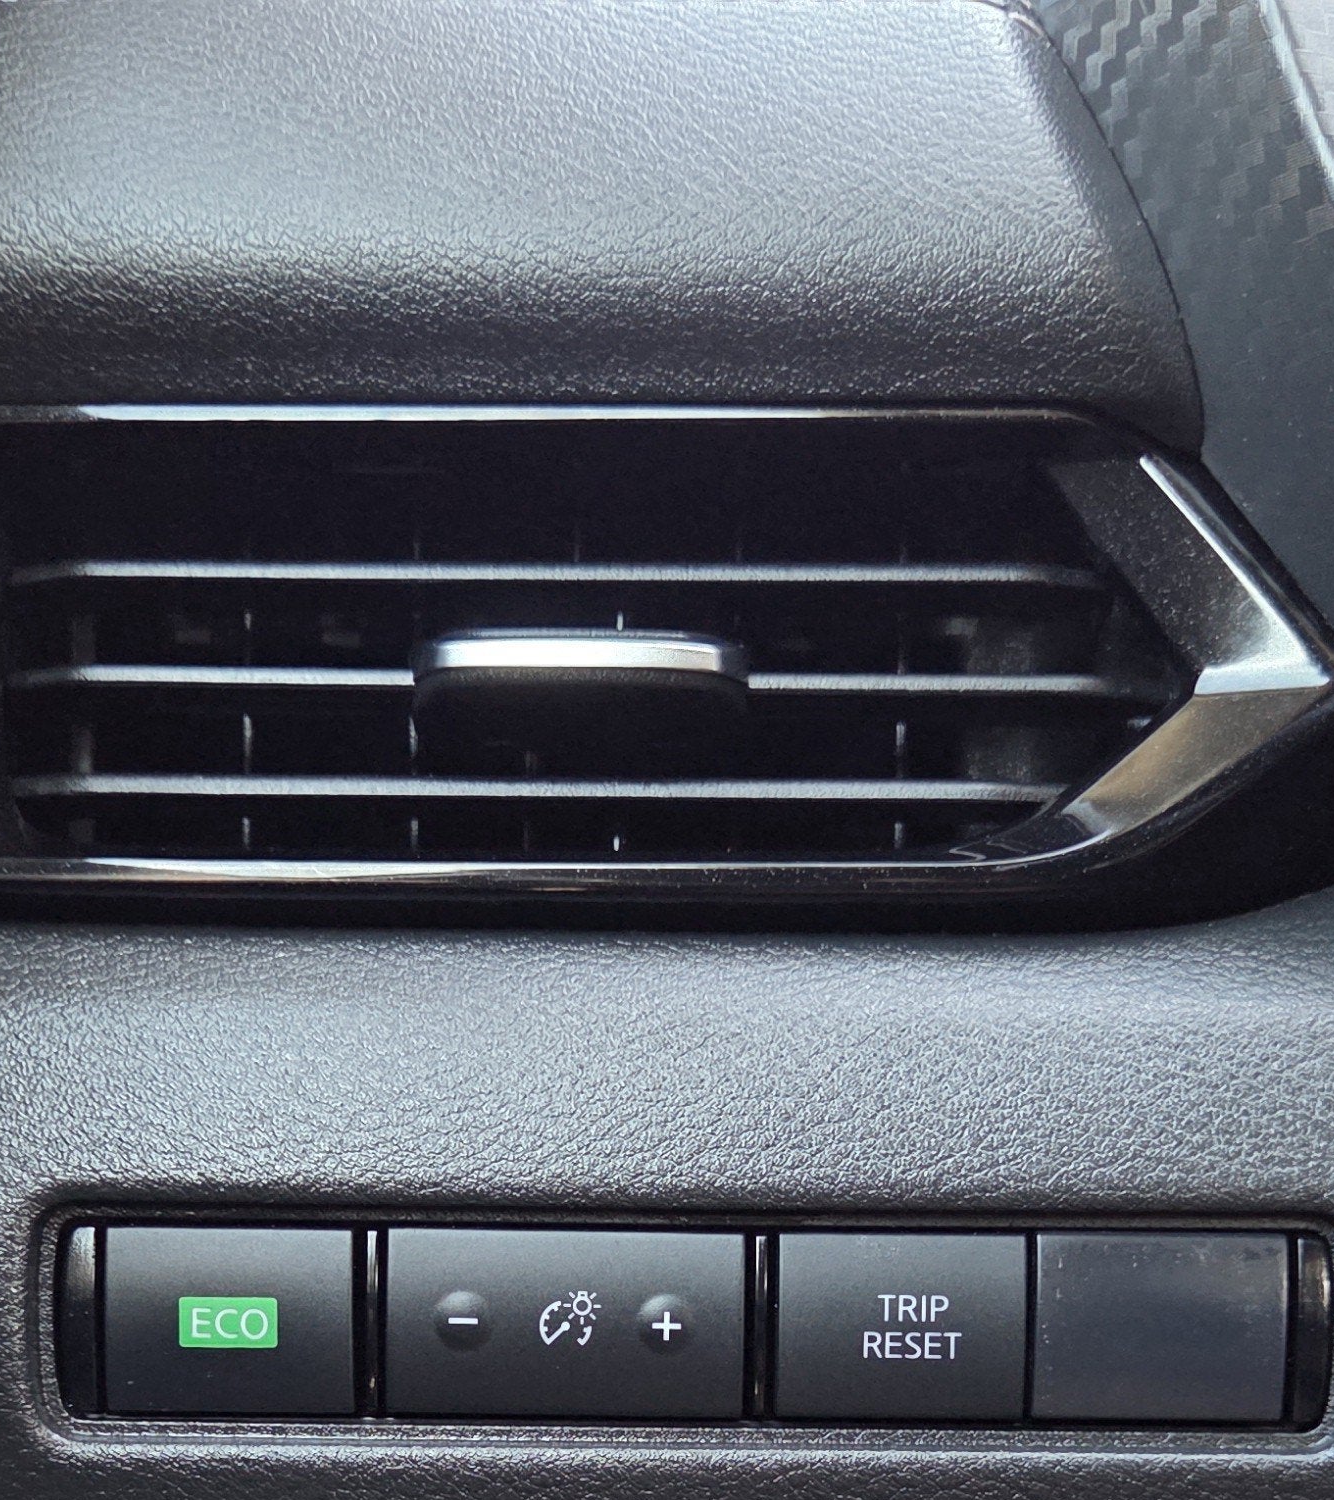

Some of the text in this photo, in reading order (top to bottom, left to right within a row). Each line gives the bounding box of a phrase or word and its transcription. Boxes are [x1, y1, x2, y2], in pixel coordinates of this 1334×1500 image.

[877, 1294, 949, 1322] TRIP
[191, 1307, 269, 1340] ECO
[862, 1331, 963, 1360] RESET
